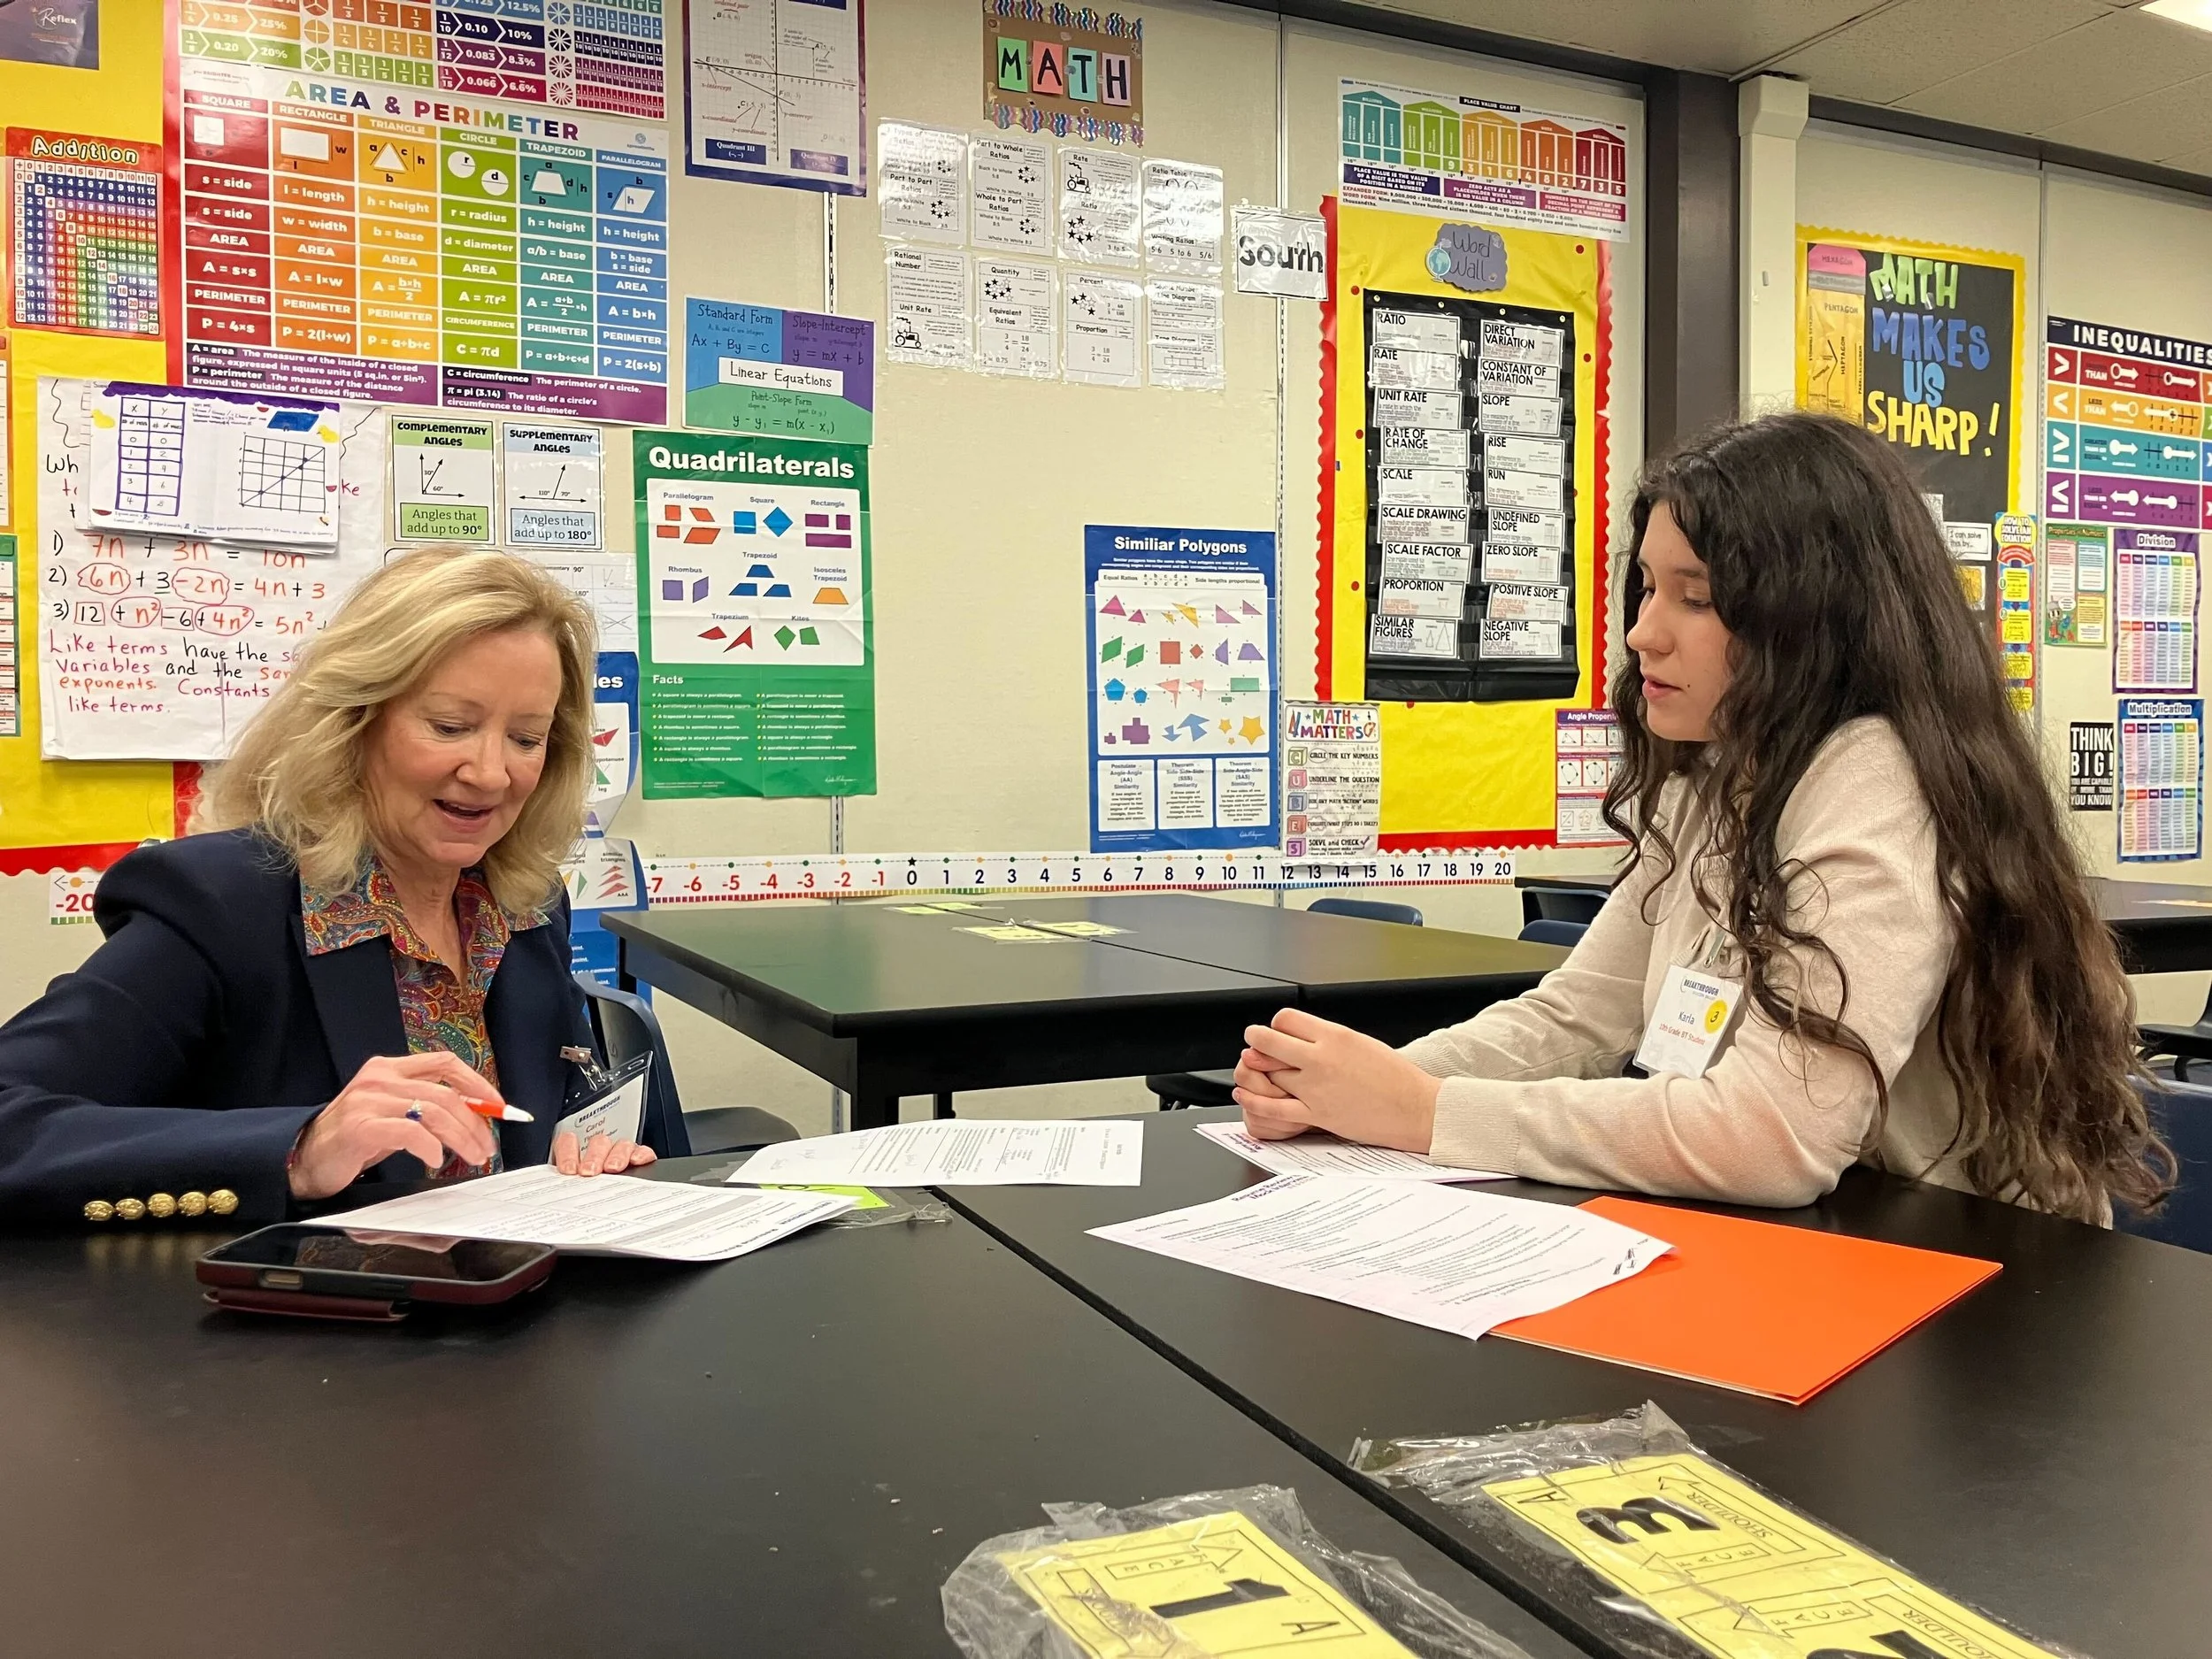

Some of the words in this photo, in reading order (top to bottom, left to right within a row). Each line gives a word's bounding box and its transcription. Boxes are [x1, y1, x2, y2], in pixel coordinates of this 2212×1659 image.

[40, 7, 76, 26] Reflex
[1001, 48, 1127, 100] MATH
[202, 96, 251, 109] SQUARE
[279, 105, 347, 122] RECTANGLE
[285, 80, 371, 110] AREA
[385, 96, 401, 114] &
[414, 100, 579, 142] PERIMETER
[370, 119, 425, 134] TRIANGLE
[460, 133, 497, 145] CIRCLE
[33, 137, 138, 164] Addition
[526, 142, 586, 157] TRAPEZOID
[1003, 143, 1023, 152] Whole
[602, 155, 661, 168] PARALLELOGRAM
[990, 151, 1010, 160] Ratios
[1452, 231, 1490, 258] Word
[895, 251, 922, 260] Rational
[991, 267, 1020, 277] Quantity
[1449, 259, 1486, 282] Wall
[1869, 251, 1958, 310] MATH
[697, 303, 745, 323] Standard
[750, 309, 773, 325] Form
[989, 307, 1022, 317] Equivalent
[1377, 312, 1406, 325] RATIO
[527, 323, 588, 337] PERIMETER
[793, 314, 866, 337] Slope-Intercept
[1076, 325, 1108, 334] Proportion
[1485, 324, 1516, 336] DIRECT
[603, 331, 662, 345] PERIMETER
[1485, 334, 1535, 349] VARIATION
[1871, 307, 1990, 371] MAKES
[1374, 349, 1398, 360] RATE
[730, 361, 768, 380] Linear
[774, 368, 833, 388] Equations
[192, 378, 228, 387] around
[231, 380, 248, 388] the
[250, 381, 287, 391] outside
[310, 388, 341, 396] closed
[342, 389, 373, 399] figure.
[1903, 360, 1945, 408] US
[751, 391, 792, 406] Point-Slope
[795, 395, 812, 407] Form
[1379, 389, 1402, 401] UNIT
[1404, 391, 1427, 403] RATE
[1482, 395, 1509, 406] SLOPE
[447, 398, 511, 411] circumference
[537, 405, 579, 415] diameter.
[1386, 428, 1409, 439] RATE
[1412, 429, 1425, 439] OF
[1386, 438, 1428, 449] CHANGE
[1488, 436, 1506, 448] RISE
[649, 446, 855, 479] Quadrilaterals
[1383, 469, 1413, 480] SCALE
[1488, 469, 1506, 480] RUN
[663, 491, 714, 502] Parallelogram
[810, 499, 845, 508] Rectangle
[412, 509, 452, 521] Angles
[455, 511, 477, 521] that
[522, 515, 559, 526] Angles
[562, 517, 584, 526] that
[1382, 507, 1414, 518] SCALE
[1417, 508, 1466, 520] DRAWING
[407, 523, 428, 533] add
[431, 526, 446, 536] up
[463, 526, 482, 534] 90°
[538, 531, 552, 541] up
[567, 531, 592, 540] 180°
[1115, 536, 1175, 551] Similiar
[1179, 539, 1247, 557] Polygons
[2138, 534, 2176, 547] Division
[742, 551, 778, 561] Trapezoid
[1387, 543, 1419, 555] SCALE
[1423, 545, 1461, 557] FACTOR
[1486, 544, 1510, 556] ZERO
[1512, 545, 1538, 557] SLOPE
[668, 565, 703, 574] Rhombus
[814, 565, 847, 574] Isosceles
[814, 574, 848, 583] Trapezoid
[1384, 580, 1444, 592] PROPORTION
[711, 612, 749, 621] Trapezium
[1376, 616, 1414, 628] SIMILAR
[1375, 626, 1413, 639] FIGURES
[49, 629, 96, 656] Like
[107, 635, 169, 656] terms
[183, 636, 228, 662] have
[234, 640, 269, 663] the
[55, 657, 150, 674] Variables
[165, 659, 199, 676] and
[211, 663, 243, 680] the
[652, 674, 684, 685] Facts
[59, 676, 157, 694] exponents.
[177, 678, 271, 698] Constants
[68, 696, 99, 713] like
[109, 699, 170, 714] terms.
[2130, 704, 2191, 715] Multiplication
[1313, 710, 1351, 725] MATH
[1301, 726, 1363, 740] MATTERS
[2070, 727, 2113, 750] THINK
[2071, 752, 2113, 776] BIG!
[722, 875, 740, 891] -5
[760, 874, 778, 889] -4
[797, 872, 815, 888] -3
[834, 872, 851, 887] -2
[872, 872, 885, 886] -1
[907, 870, 917, 885] 0
[943, 870, 949, 884] 1
[1684, 979, 1719, 996] BREAKTHROUGH
[1678, 1012, 1695, 1025] Karla
[1710, 1011, 1719, 1023] 3
[579, 1095, 620, 1123] BREAKTHROUGH
[586, 1118, 605, 1133] Carol
[1517, 1491, 1567, 1504] A
[1576, 1497, 1720, 1545] 3
[1686, 1493, 1773, 1540] SHOULDER
[1677, 1548, 1755, 1569] FACE
[1148, 1578, 1292, 1618] 1
[1281, 1620, 1341, 1635] A
